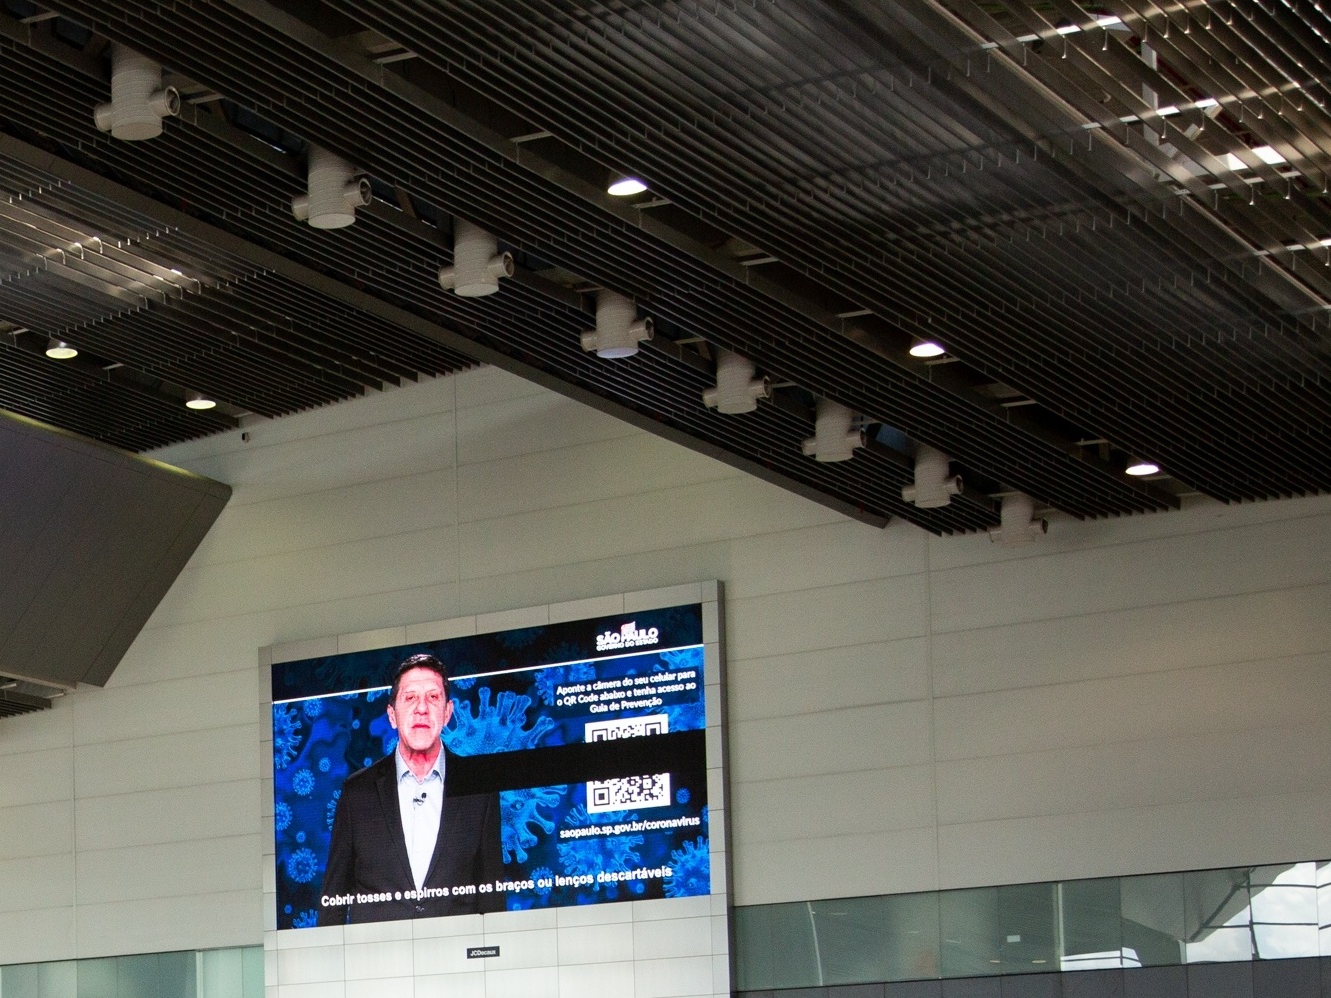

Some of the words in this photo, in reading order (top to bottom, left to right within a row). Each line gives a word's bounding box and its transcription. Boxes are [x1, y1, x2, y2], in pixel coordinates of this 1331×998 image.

[596, 630, 621, 646] SÃO
[621, 627, 659, 642] PAULO
[556, 683, 585, 696] Aponte
[592, 679, 621, 690] câmera
[622, 677, 633, 686] do
[634, 676, 649, 685] seu
[649, 672, 676, 683] celular
[677, 670, 696, 682] para
[563, 695, 577, 707] QR
[577, 691, 599, 703] Code
[599, 689, 625, 702] abaixo
[632, 685, 657, 697] tenha
[657, 683, 683, 694] acesso
[685, 682, 696, 691] ao
[589, 702, 609, 713] Guia
[610, 701, 620, 710] de
[621, 697, 663, 710] Prevenção
[559, 815, 700, 838] saopaulo.sp.gov.br/coronavirus
[321, 893, 355, 907] Cobrir
[356, 890, 392, 904] tosses
[394, 890, 402, 900] e
[404, 886, 449, 902] espirros
[452, 884, 476, 896] com
[478, 883, 493, 893] os
[495, 876, 535, 893] braços
[537, 876, 553, 888] ou
[555, 872, 594, 890] lenços
[596, 865, 673, 884] descartáveis
